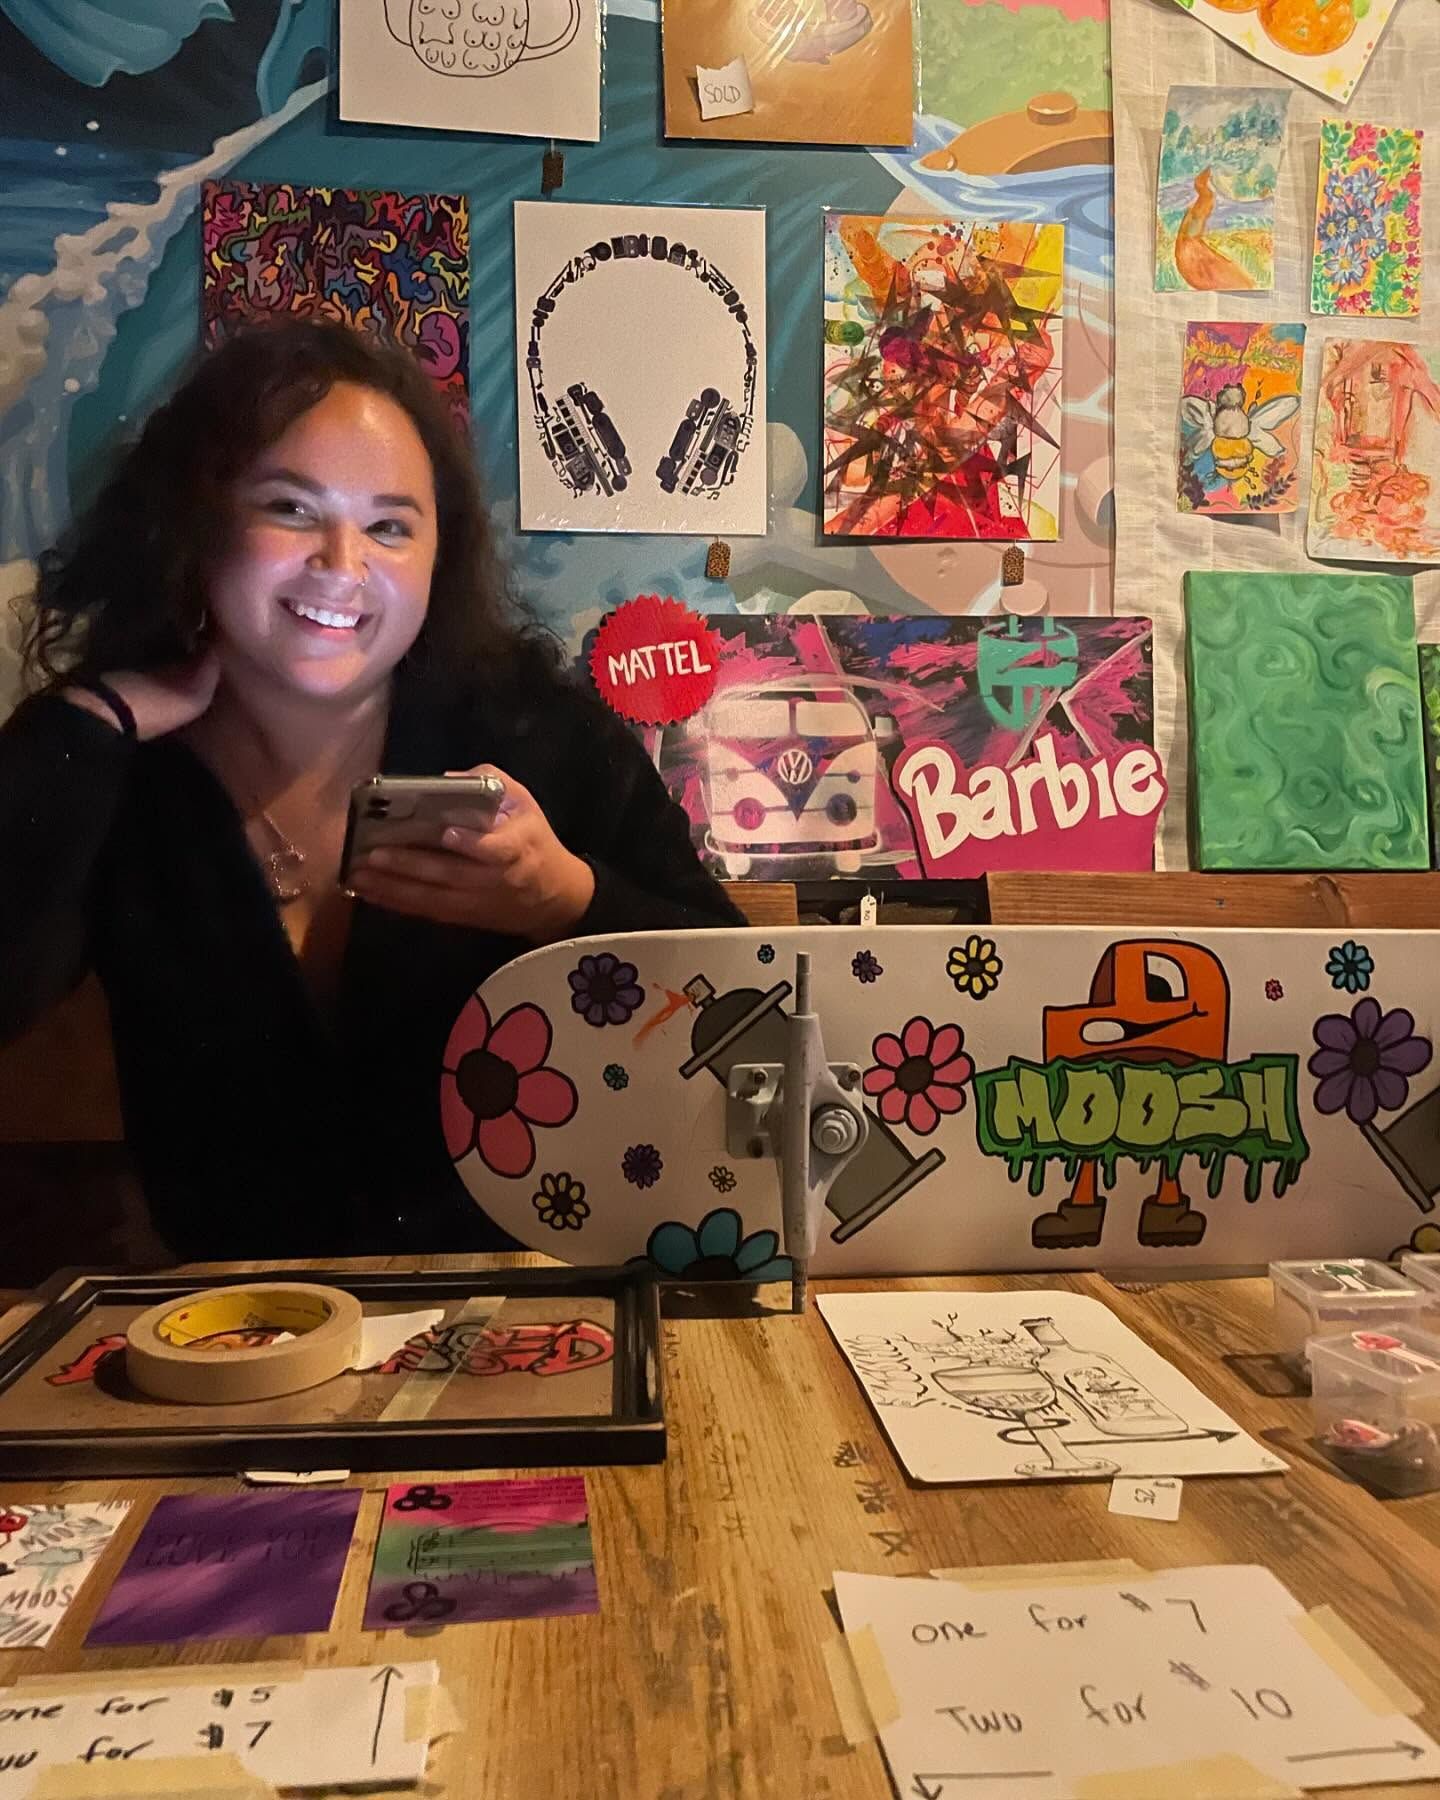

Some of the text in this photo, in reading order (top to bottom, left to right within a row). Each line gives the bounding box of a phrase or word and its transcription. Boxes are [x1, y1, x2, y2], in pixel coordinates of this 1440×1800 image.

[703, 83, 741, 104] SOLD
[607, 640, 712, 686] MATTEL
[900, 732, 1165, 861] Barbie
[991, 1058, 1297, 1150] MOOSH
[911, 1620, 987, 1645] one
[1027, 1603, 1089, 1634] for
[94, 1695, 171, 1716] for
[934, 1705, 1023, 1735] Two
[1079, 1685, 1148, 1727] for
[77, 1735, 155, 1764] for
